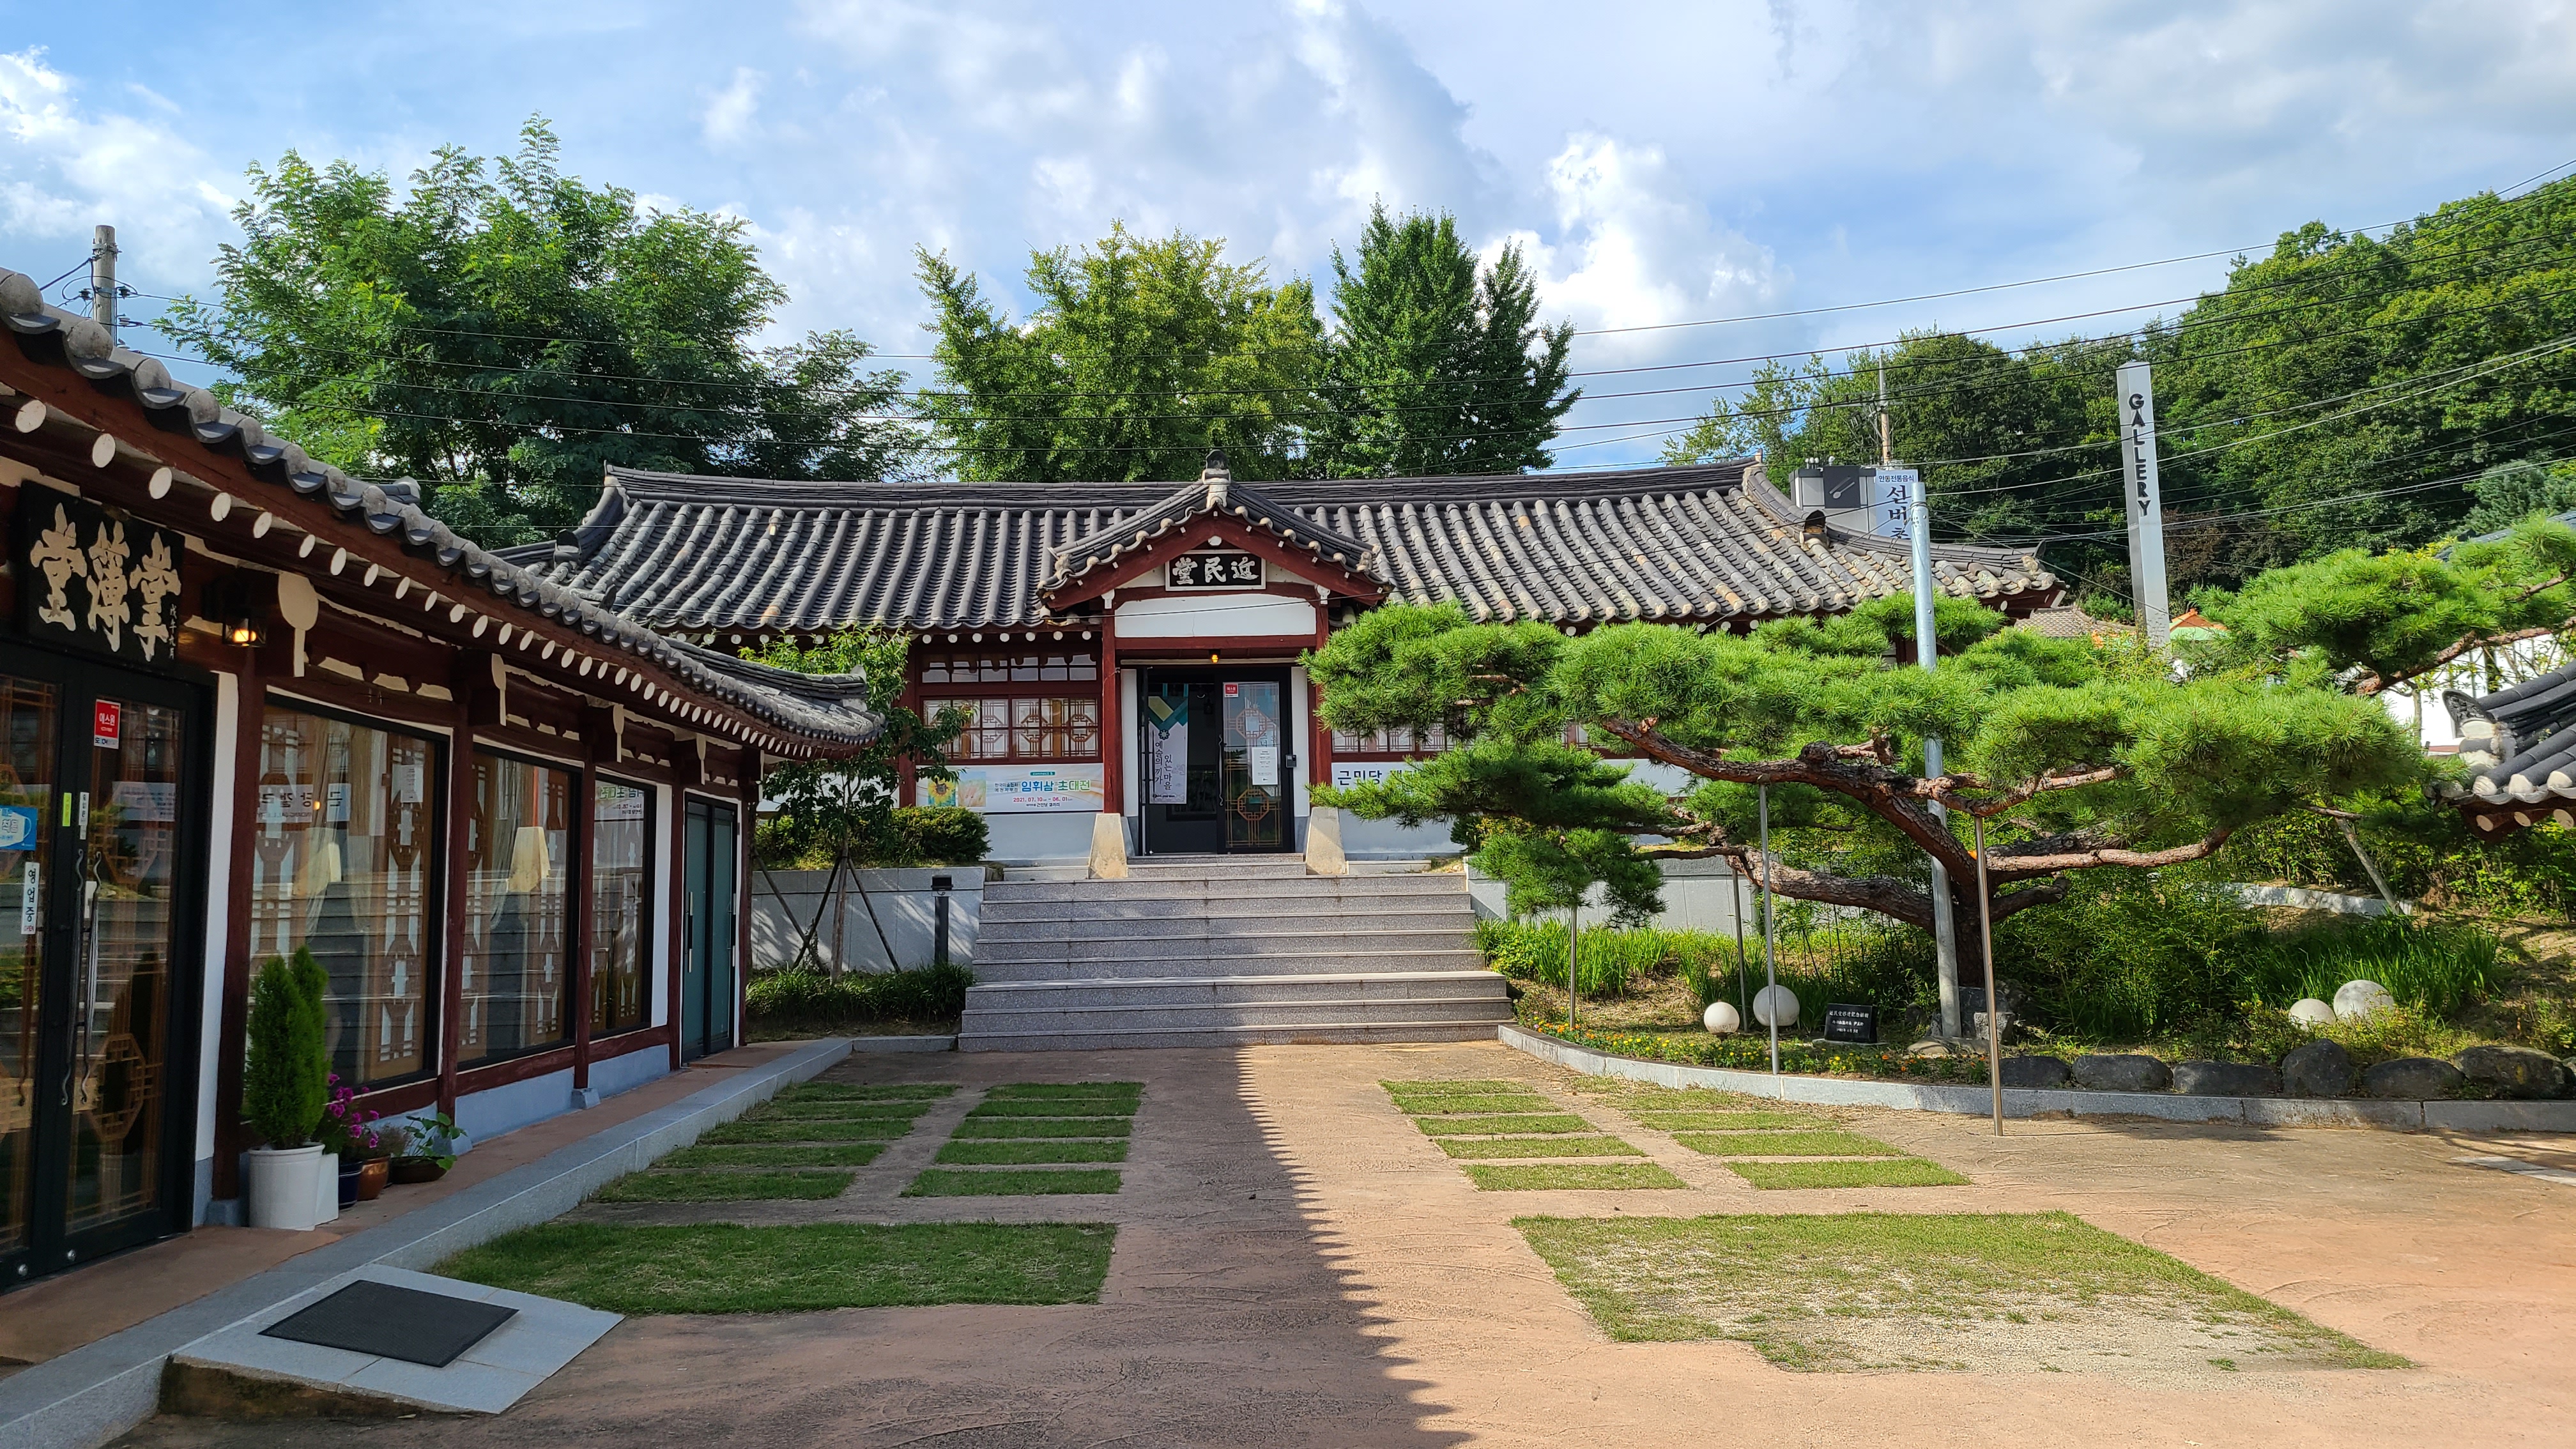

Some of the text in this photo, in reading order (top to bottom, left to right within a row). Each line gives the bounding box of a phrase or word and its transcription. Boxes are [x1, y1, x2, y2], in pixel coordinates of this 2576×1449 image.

[2129, 394, 2150, 516] GALLERY
[99, 713, 115, 726] 에스원
[1164, 755, 1172, 772] 있는
[1154, 767, 1163, 785] 끼가
[1164, 773, 1172, 790] 마을
[1022, 779, 1090, 792] 임휘삼 초대전
[26, 868, 36, 923] 영업중
